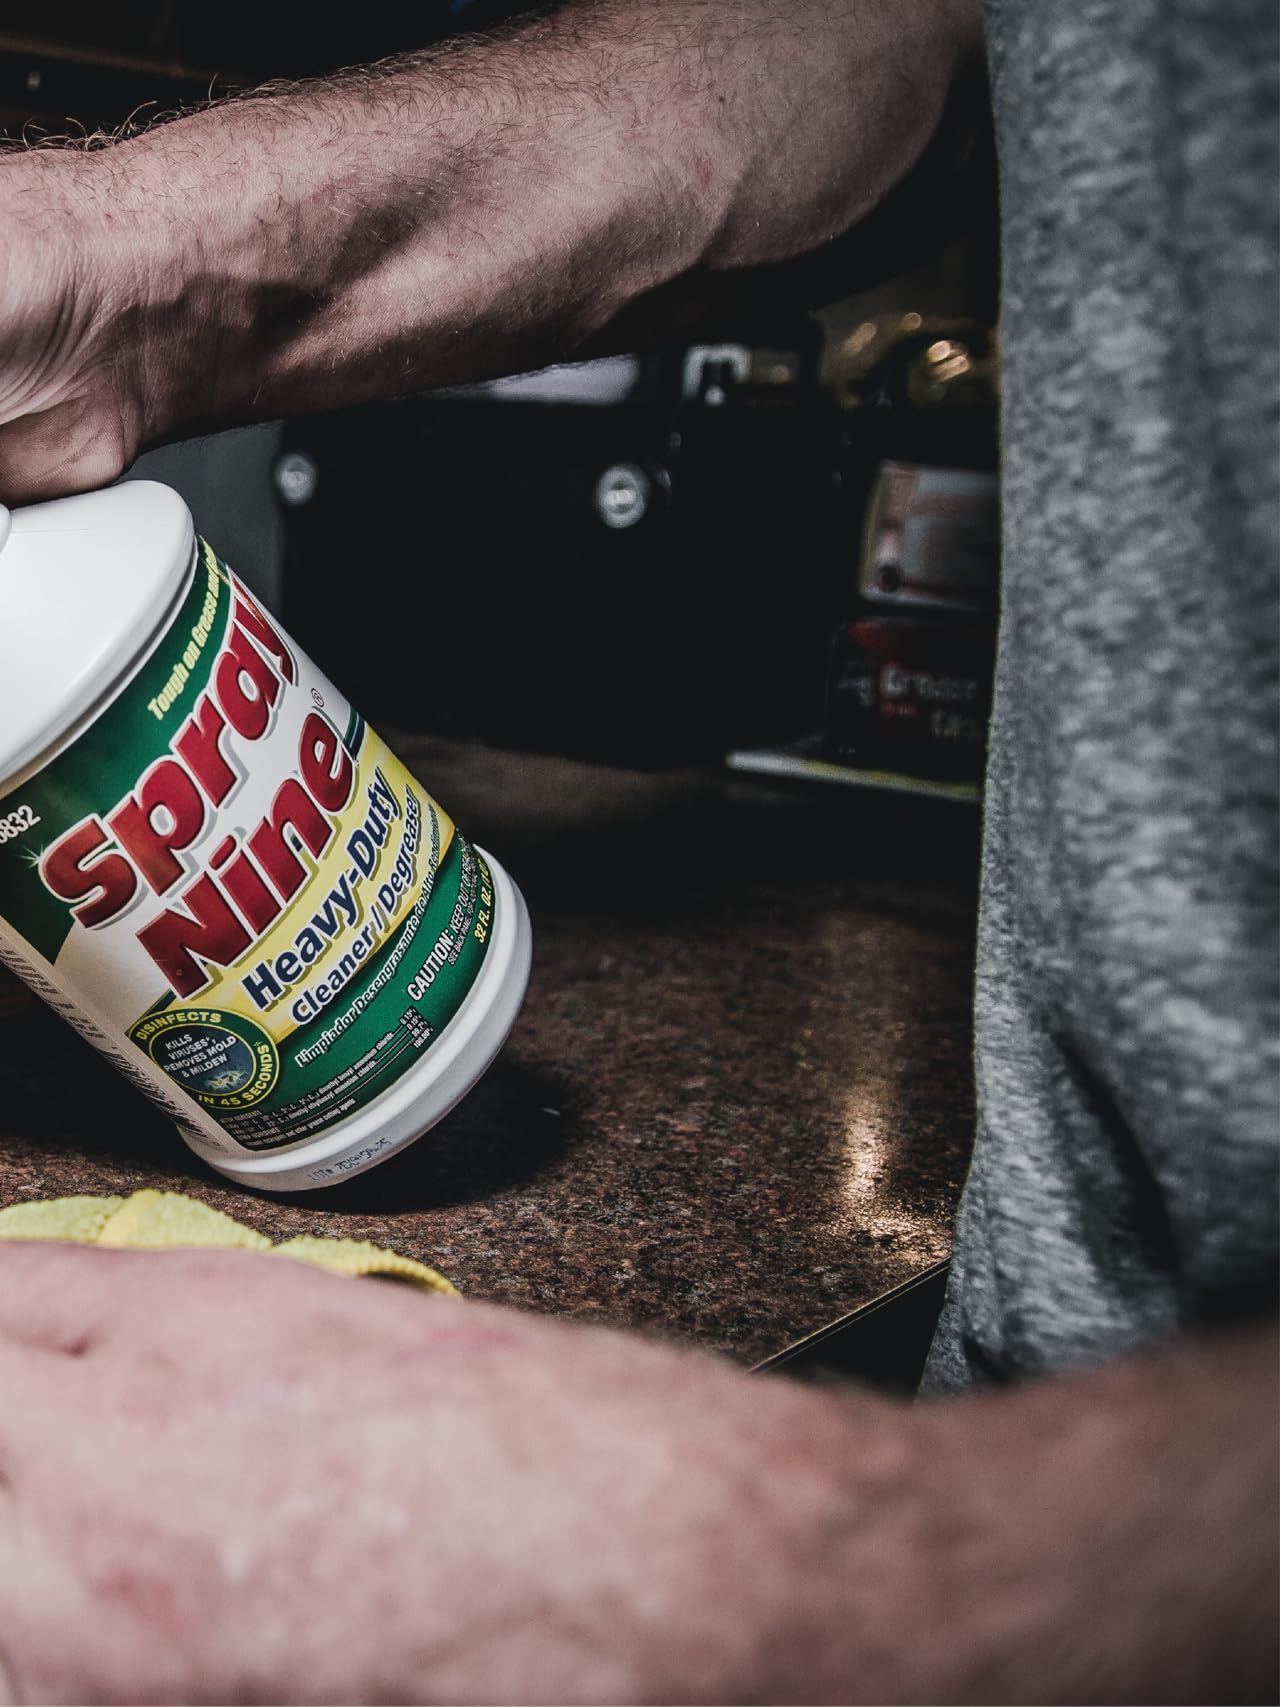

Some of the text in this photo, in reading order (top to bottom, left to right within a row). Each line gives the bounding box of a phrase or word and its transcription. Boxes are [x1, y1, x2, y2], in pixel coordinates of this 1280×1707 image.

[147, 663, 189, 720] Tough
[183, 640, 200, 670] on
[192, 592, 218, 647] Grease
[40, 575, 294, 929] Spray
[136, 711, 354, 998] Nine
[241, 769, 400, 1010] Heavy-Duty
[291, 924, 373, 1024] Cleaner
[377, 783, 420, 914] Degreaser
[481, 887, 491, 906] OZ.
[474, 923, 486, 943] 32
[478, 910, 490, 927] FL.
[407, 928, 454, 1001] CAUTION:
[450, 904, 465, 933] KEEP
[458, 882, 469, 906] OUT
[448, 949, 459, 965] SEE
[295, 1005, 357, 1067] Limpiador
[353, 916, 418, 1015] Desengrasante
[415, 896, 427, 919] de
[421, 872, 434, 900] Alto
[136, 1011, 222, 1041] DISINFECTS
[165, 1034, 193, 1050] KILLS
[164, 1036, 237, 1073] REMOVES MOLD
[181, 1053, 228, 1078] & MILDEW
[198, 1095, 214, 1105] IN
[221, 1097, 241, 1105] 45
